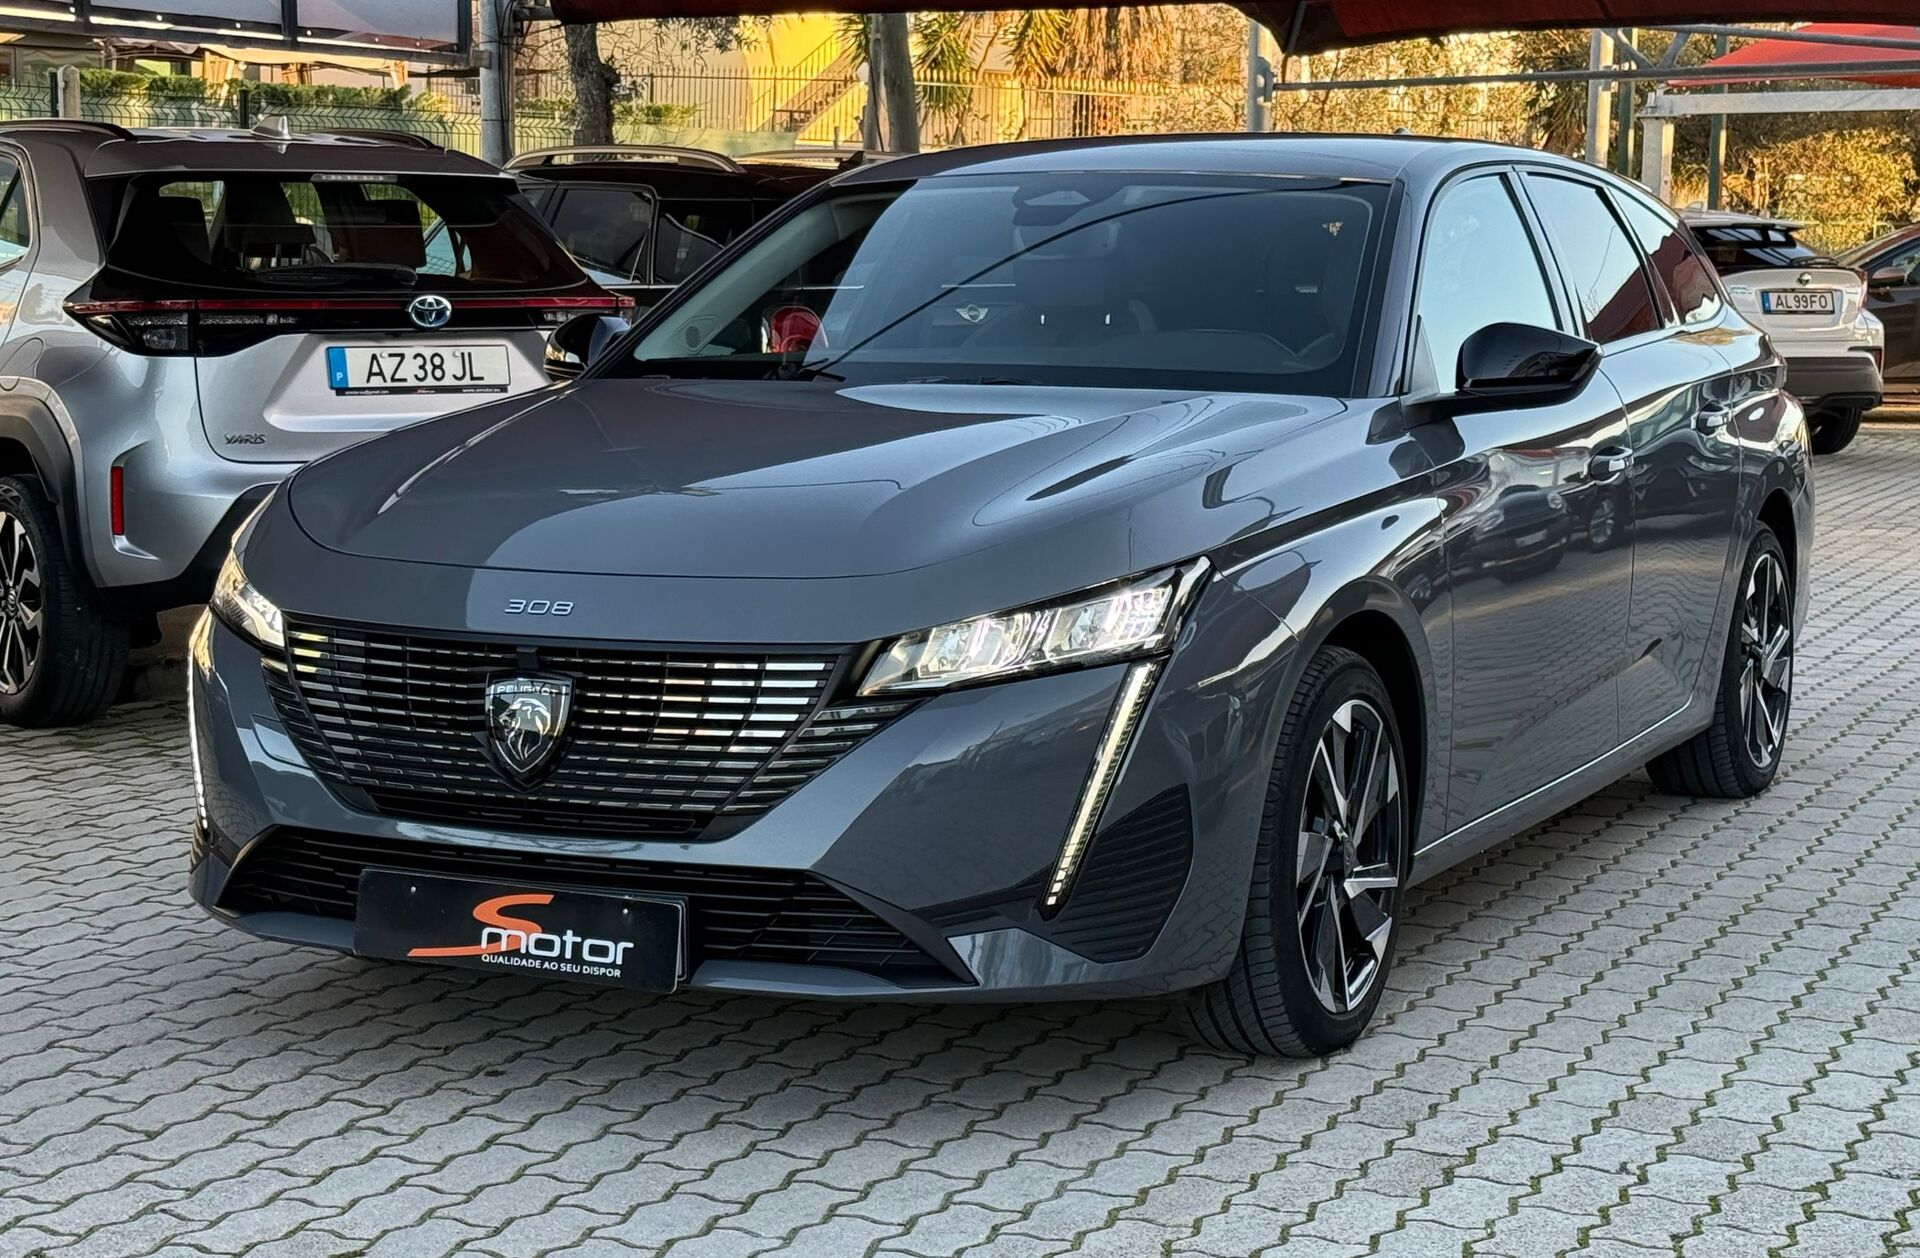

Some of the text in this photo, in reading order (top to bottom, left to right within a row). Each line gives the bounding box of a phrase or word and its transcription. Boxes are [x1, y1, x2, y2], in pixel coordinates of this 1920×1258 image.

[224, 432, 267, 445] YARIS
[504, 599, 574, 616] 308
[481, 953, 621, 978] QUALIDADE AO SEU DISPOR
